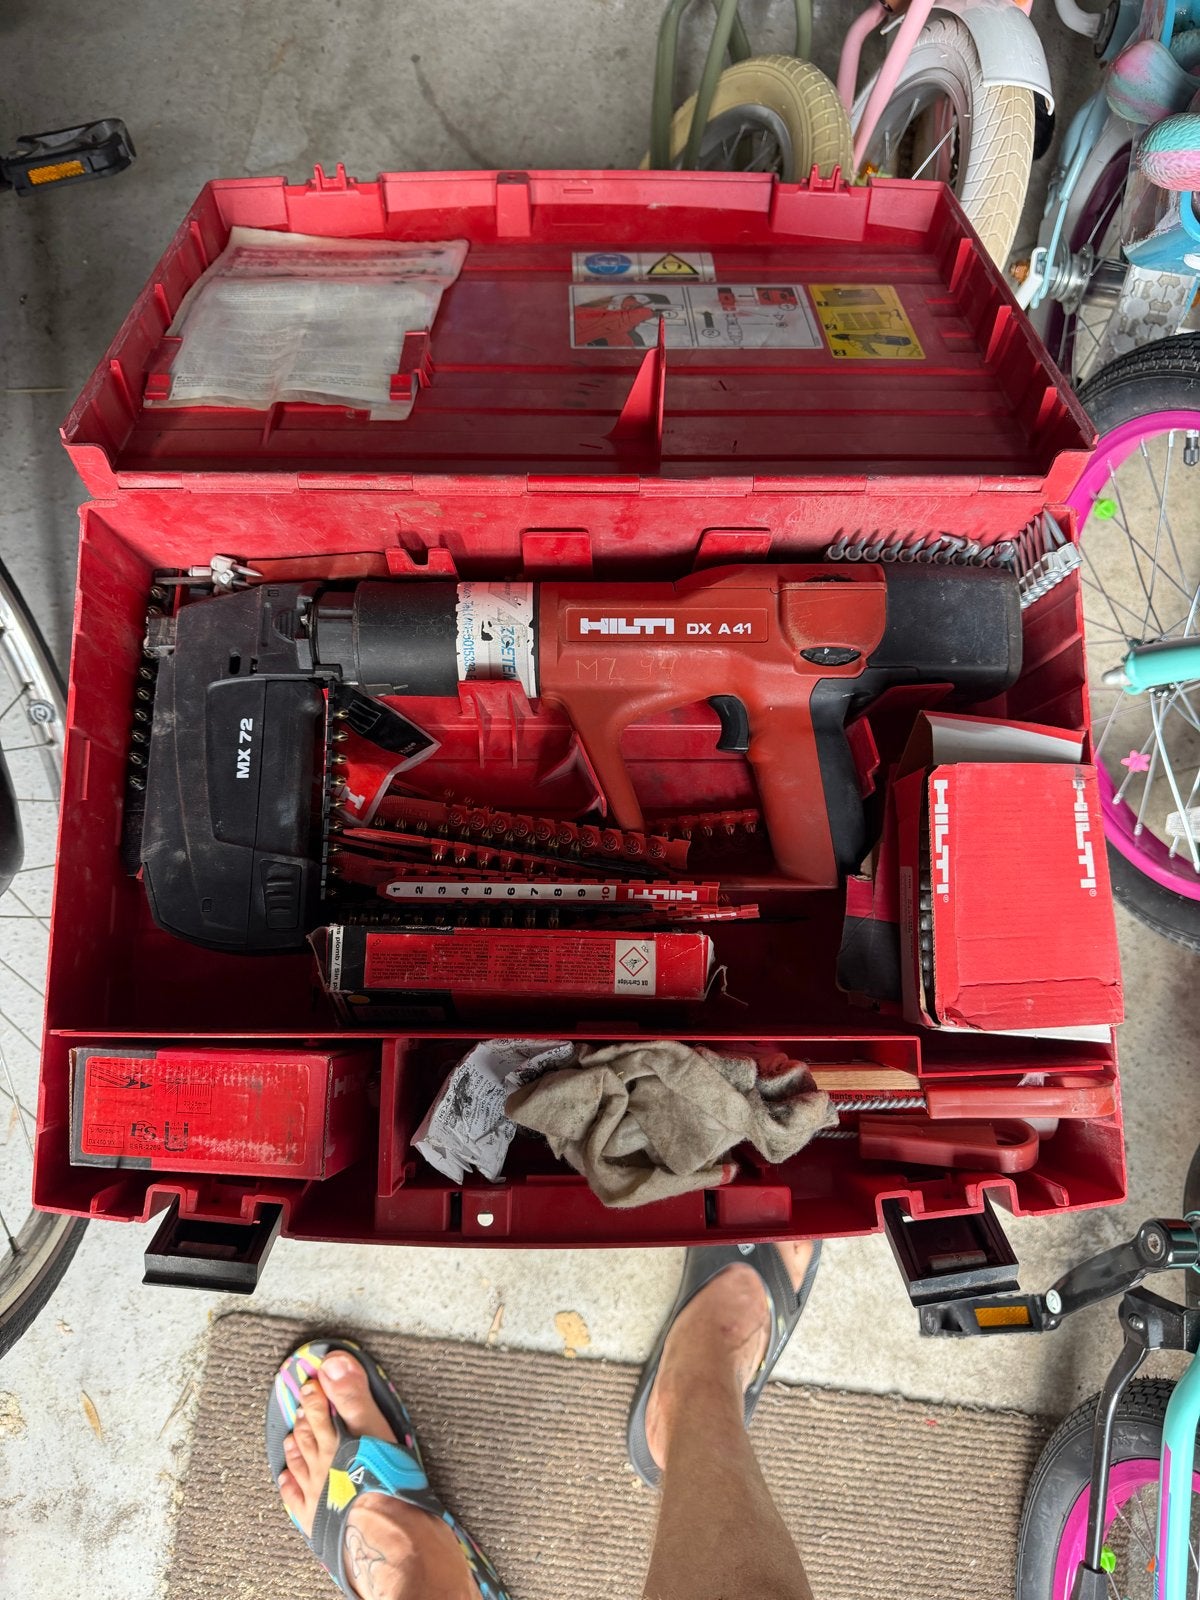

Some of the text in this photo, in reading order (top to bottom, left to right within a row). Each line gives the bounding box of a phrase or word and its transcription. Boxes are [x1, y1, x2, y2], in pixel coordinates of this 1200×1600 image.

[580, 617, 752, 635] HILTI DX A41
[236, 717, 254, 779] MX 72
[415, 886, 424, 894] 2
[438, 886, 446, 894] 3
[461, 887, 469, 895] 4
[484, 887, 492, 895] 5
[507, 887, 515, 895] 6
[530, 888, 539, 896] 7
[554, 888, 562, 896] 8
[577, 888, 586, 896] 9
[601, 886, 610, 900] 10
[627, 889, 698, 901] HILTI
[334, 936, 342, 961] plomb
